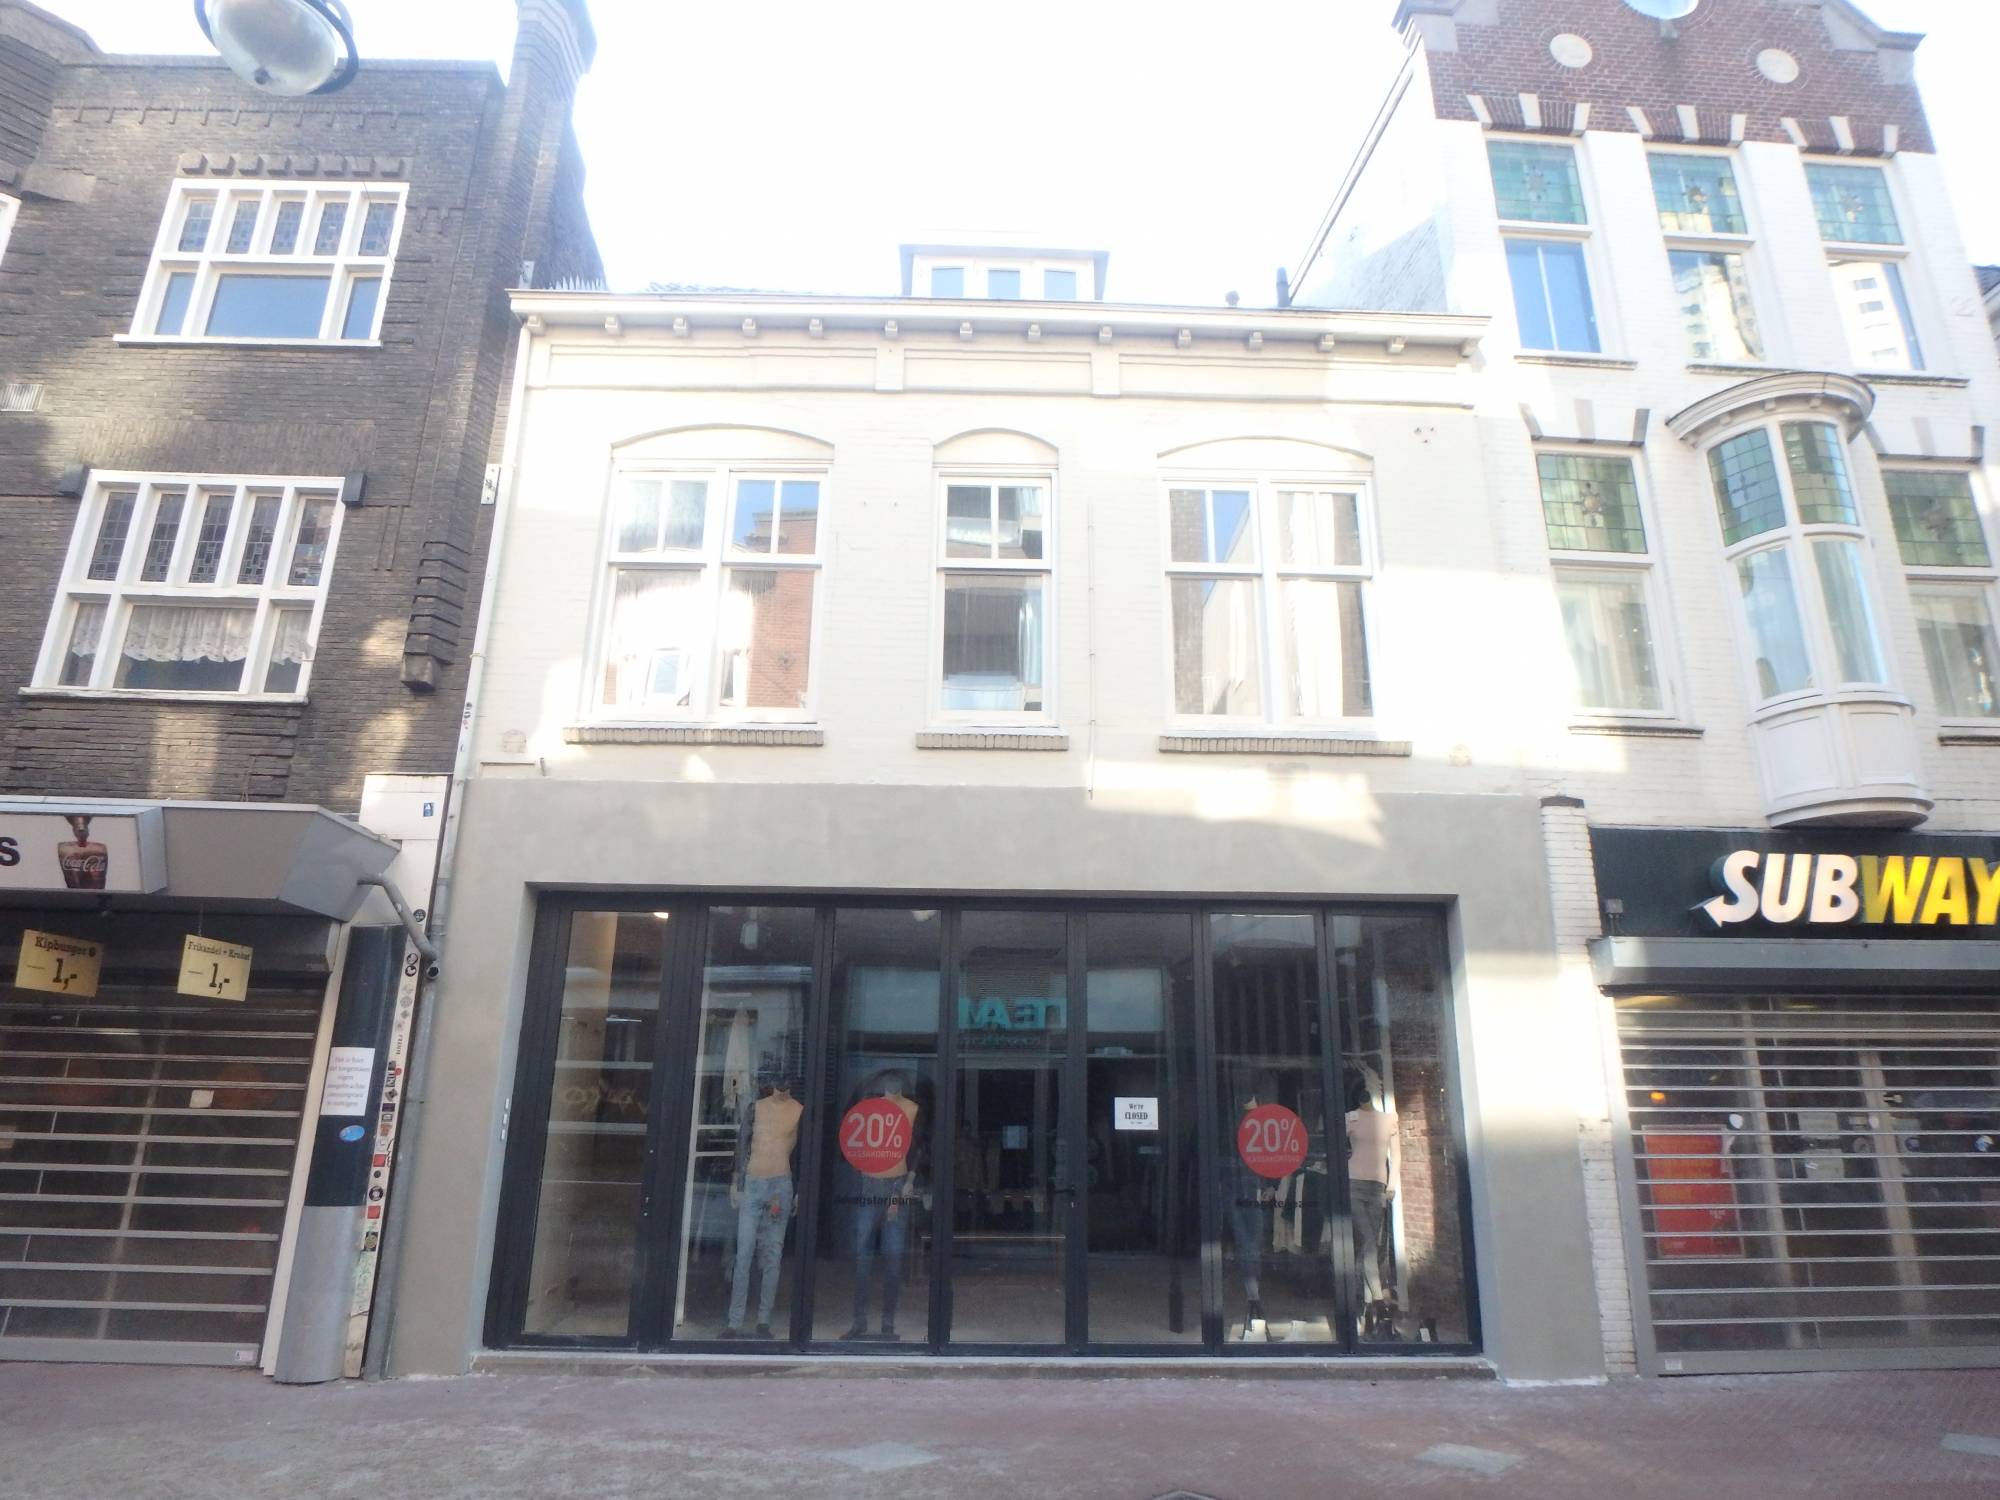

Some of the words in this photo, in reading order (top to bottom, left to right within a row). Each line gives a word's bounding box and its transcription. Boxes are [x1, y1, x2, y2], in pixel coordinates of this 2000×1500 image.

[1704, 850, 2000, 927] SUBWAY
[847, 1112, 902, 1149] 20%
[1124, 1111, 1149, 1120] CLOSED
[1244, 1118, 1300, 1153] 20%
